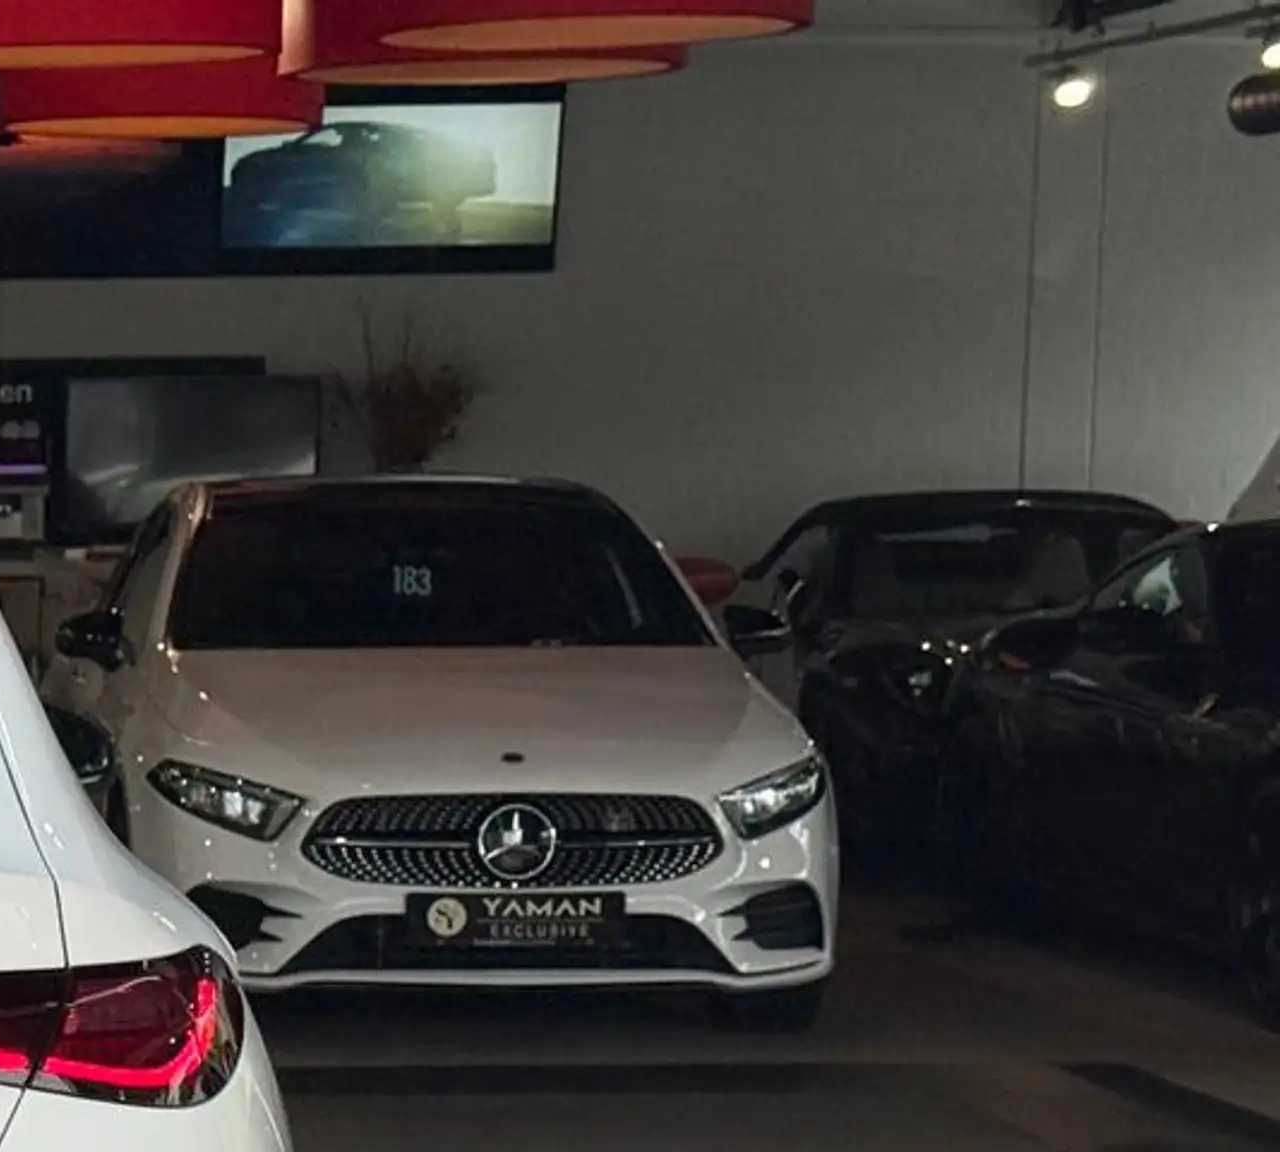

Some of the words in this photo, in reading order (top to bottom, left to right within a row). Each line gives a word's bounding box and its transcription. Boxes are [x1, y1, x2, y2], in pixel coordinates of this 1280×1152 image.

[393, 565, 431, 596] 183
[482, 898, 602, 916] YAMAN
[490, 924, 590, 937] EXCLUSIVE
